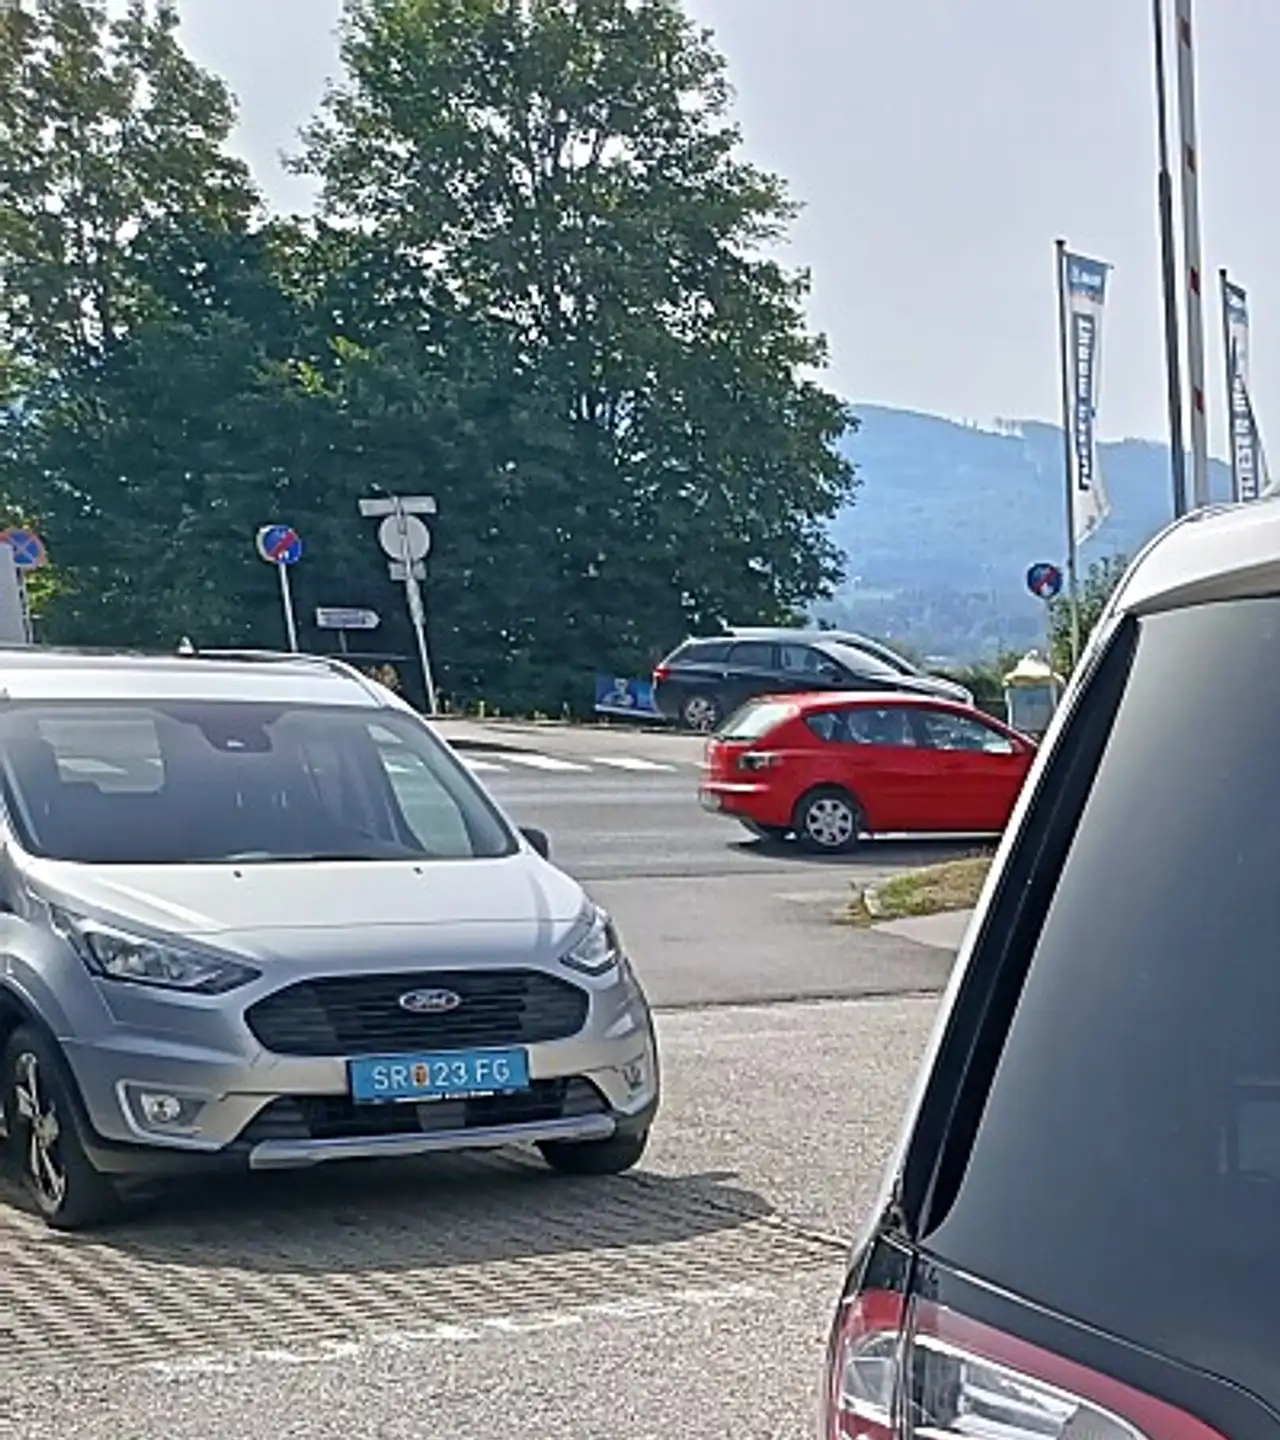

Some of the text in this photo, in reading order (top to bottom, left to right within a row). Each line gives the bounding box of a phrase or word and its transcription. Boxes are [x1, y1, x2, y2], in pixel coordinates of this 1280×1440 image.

[371, 1058, 511, 1090] SR 23 FG
